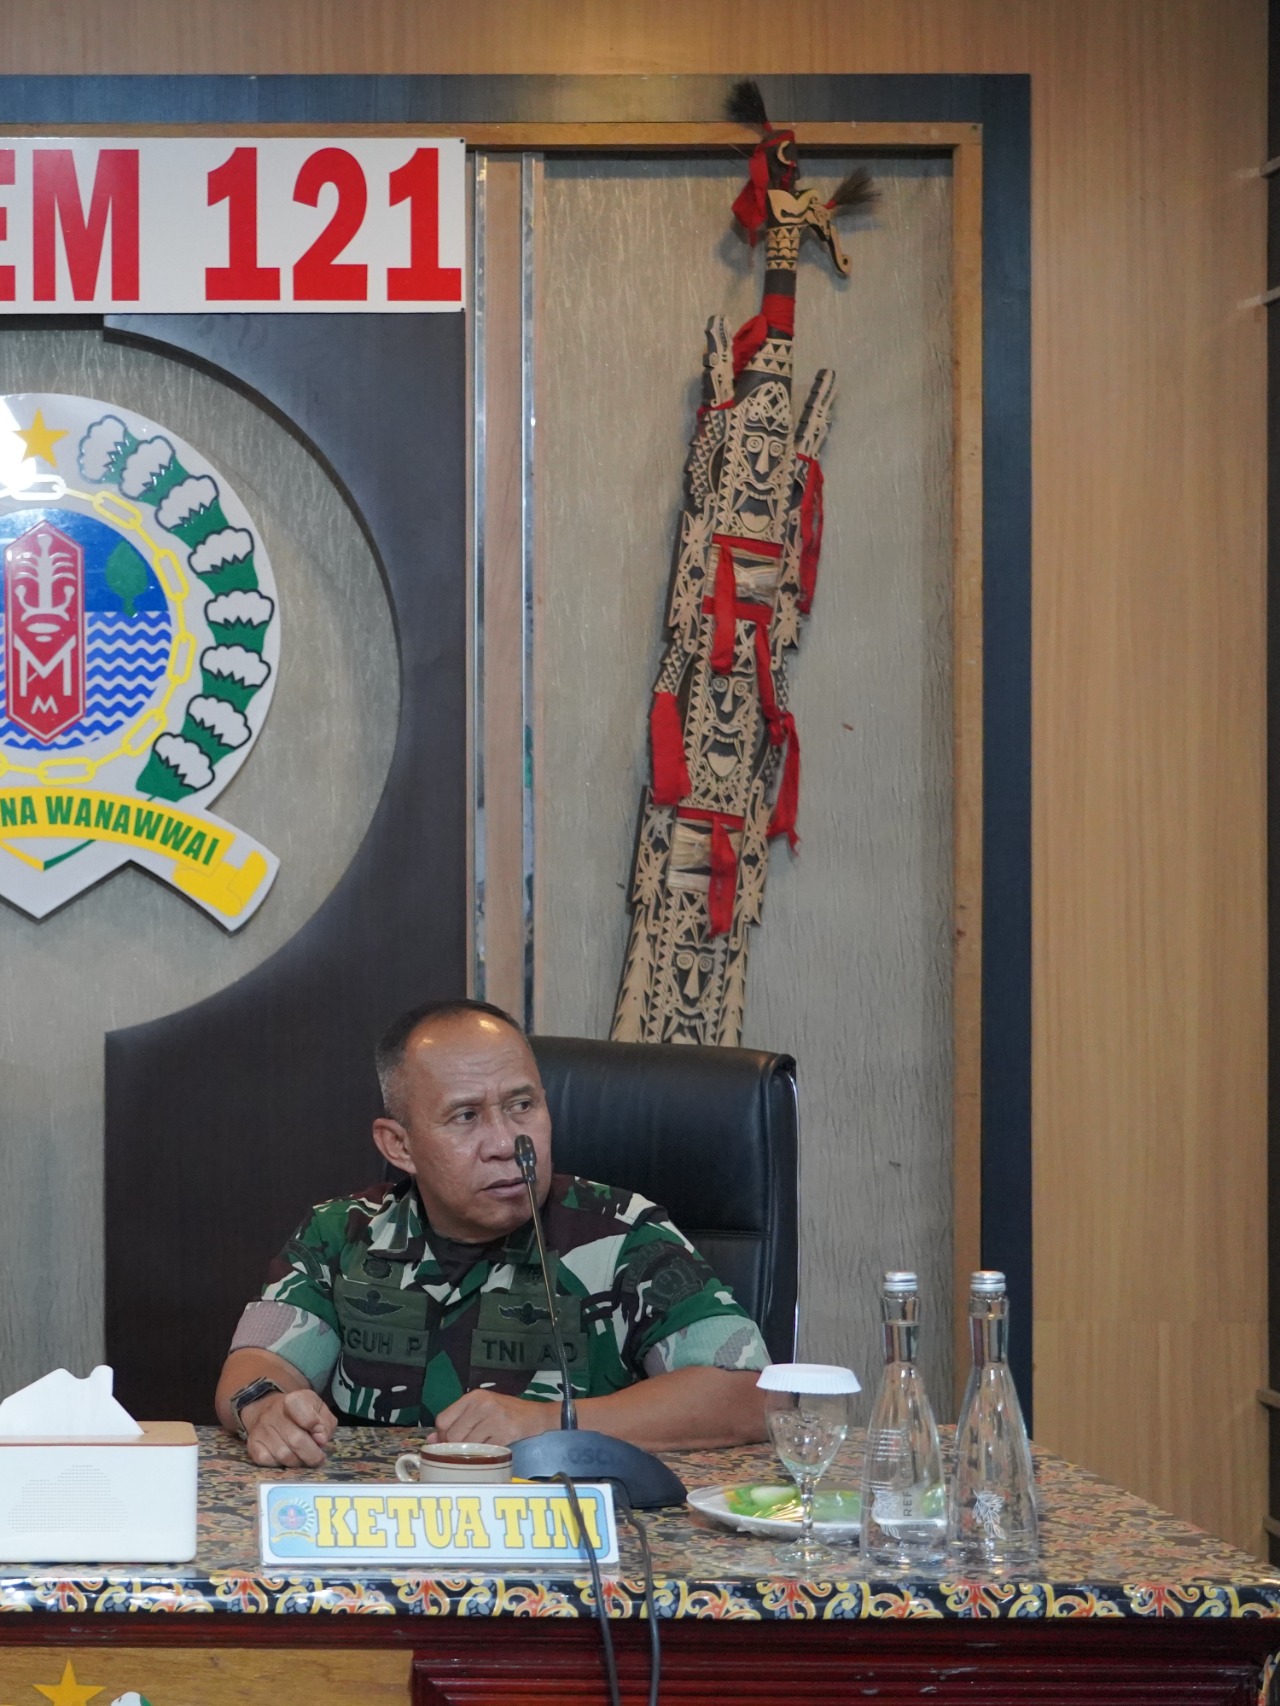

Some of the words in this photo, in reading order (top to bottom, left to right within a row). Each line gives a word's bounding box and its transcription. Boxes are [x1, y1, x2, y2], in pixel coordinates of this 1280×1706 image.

[205, 147, 462, 302] 121
[45, 796, 220, 866] WANAWWAI
[344, 1326, 394, 1356] GUH
[405, 1335, 423, 1358] P
[482, 1338, 525, 1364] TNI
[314, 1496, 491, 1549] KETUA
[495, 1496, 602, 1550] TIM
